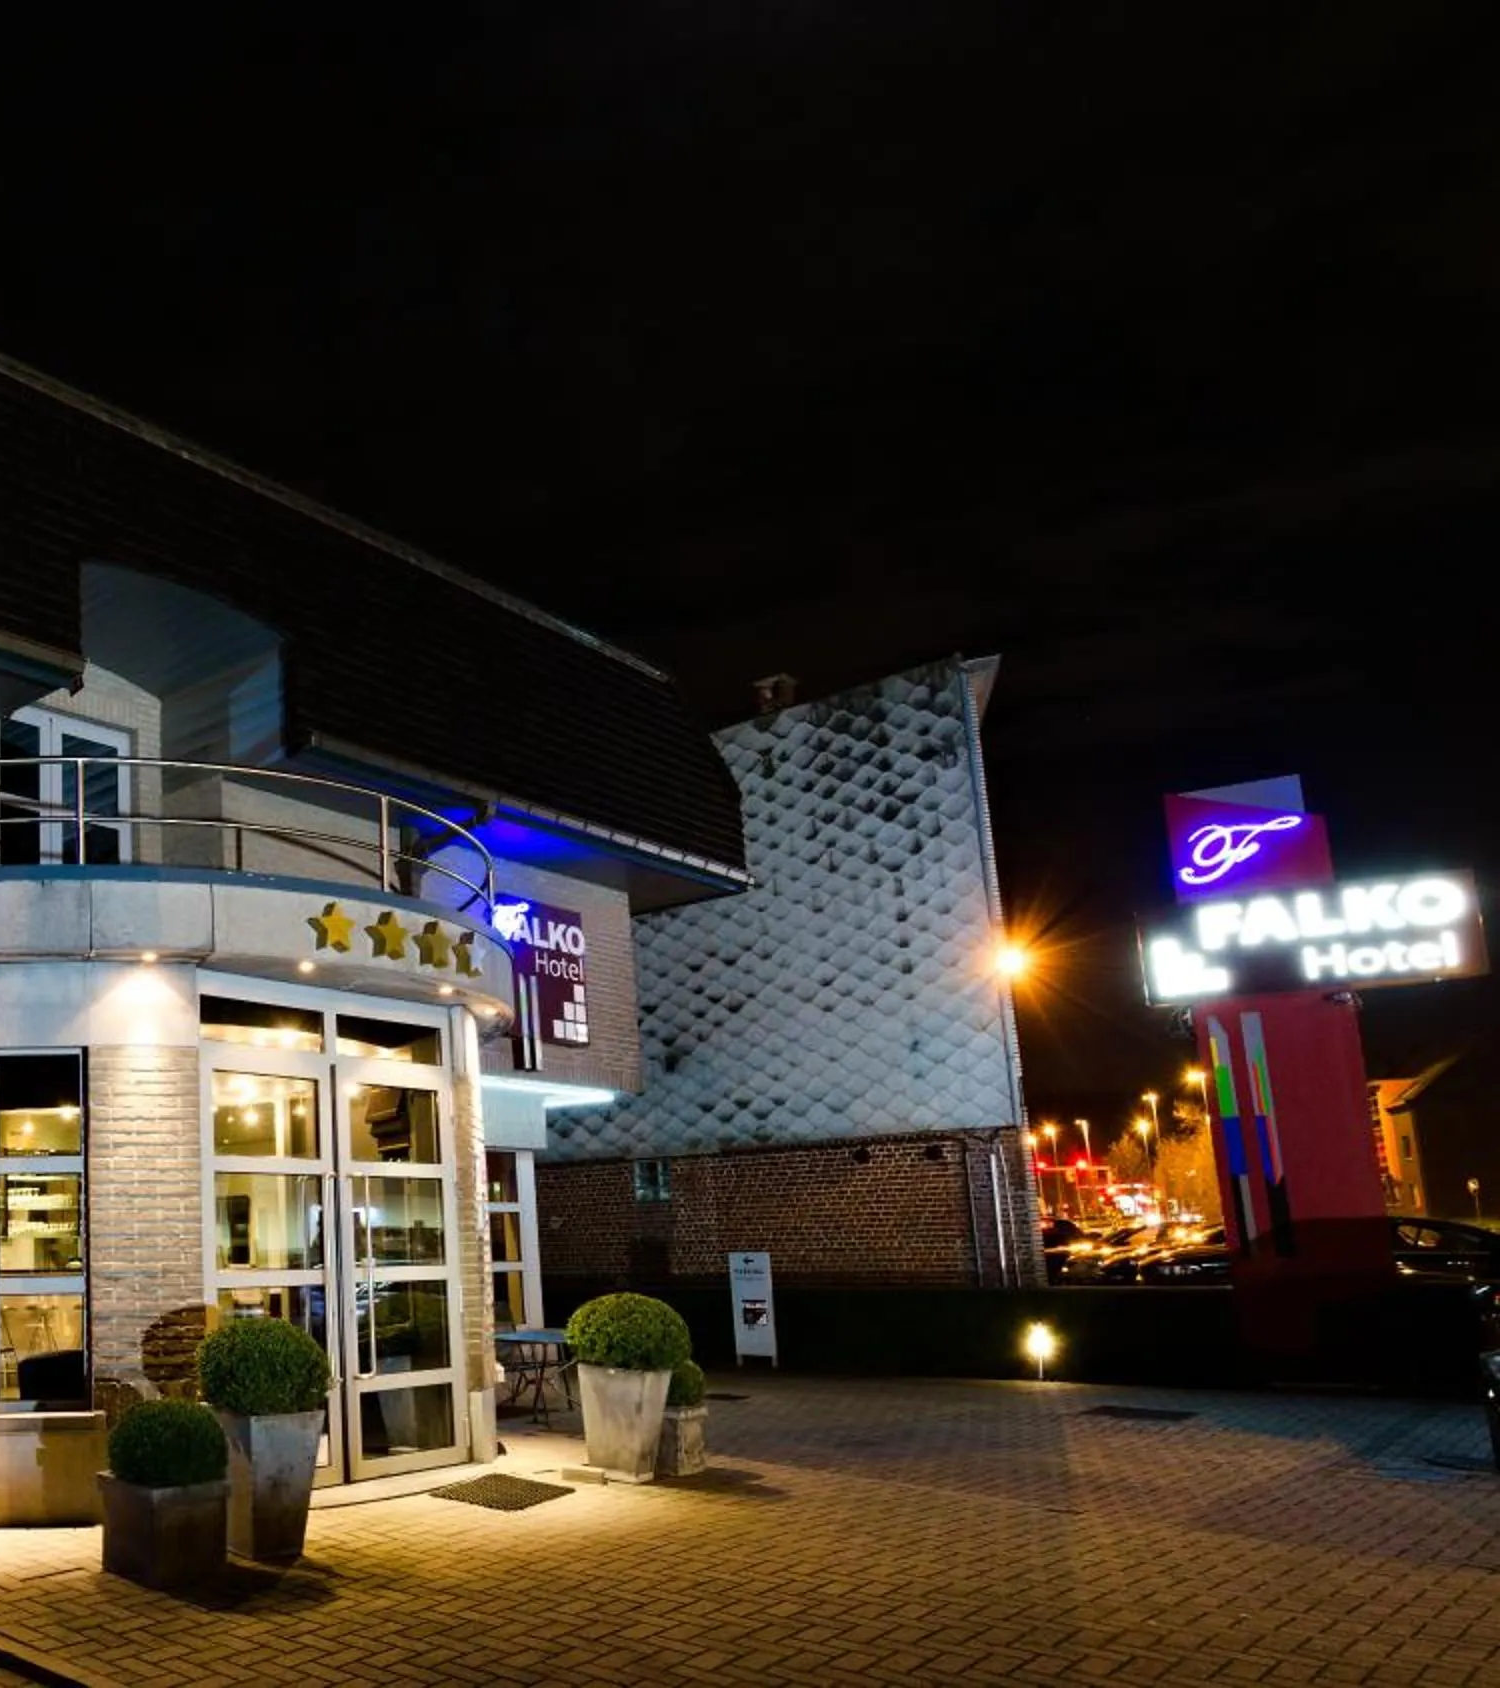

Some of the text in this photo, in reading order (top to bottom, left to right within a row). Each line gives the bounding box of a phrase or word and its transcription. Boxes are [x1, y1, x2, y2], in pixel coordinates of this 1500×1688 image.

[1196, 877, 1467, 950] FALKO
[535, 952, 585, 981] Hotel
[1301, 930, 1461, 981] Hotel
